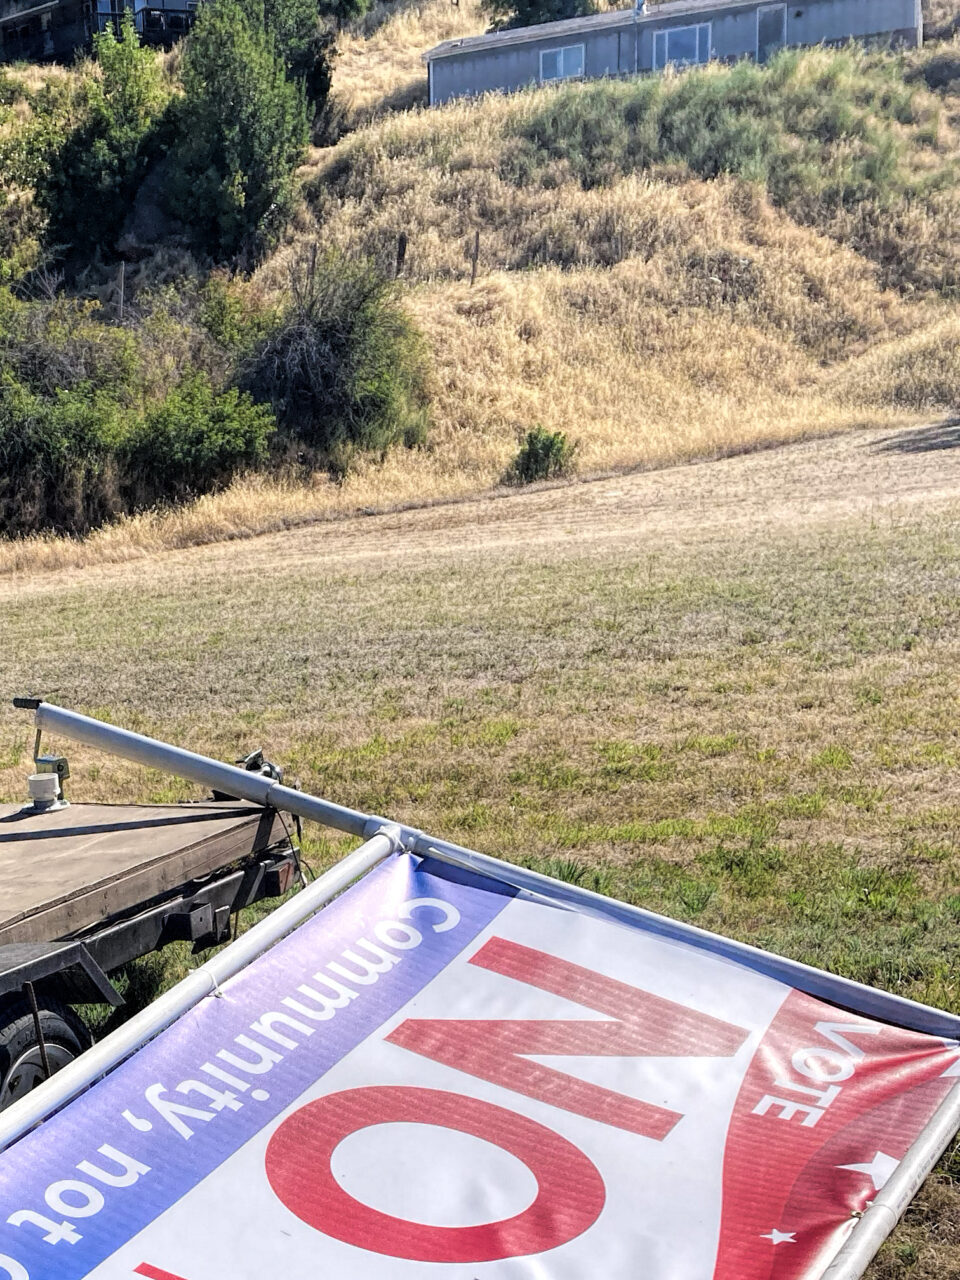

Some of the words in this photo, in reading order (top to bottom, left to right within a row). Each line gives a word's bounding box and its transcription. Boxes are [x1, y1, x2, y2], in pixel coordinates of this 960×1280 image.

[121, 897, 461, 1141] Community,
[265, 936, 752, 1265] NO
[751, 1020, 883, 1128] VOTE
[6, 1143, 152, 1246] not
